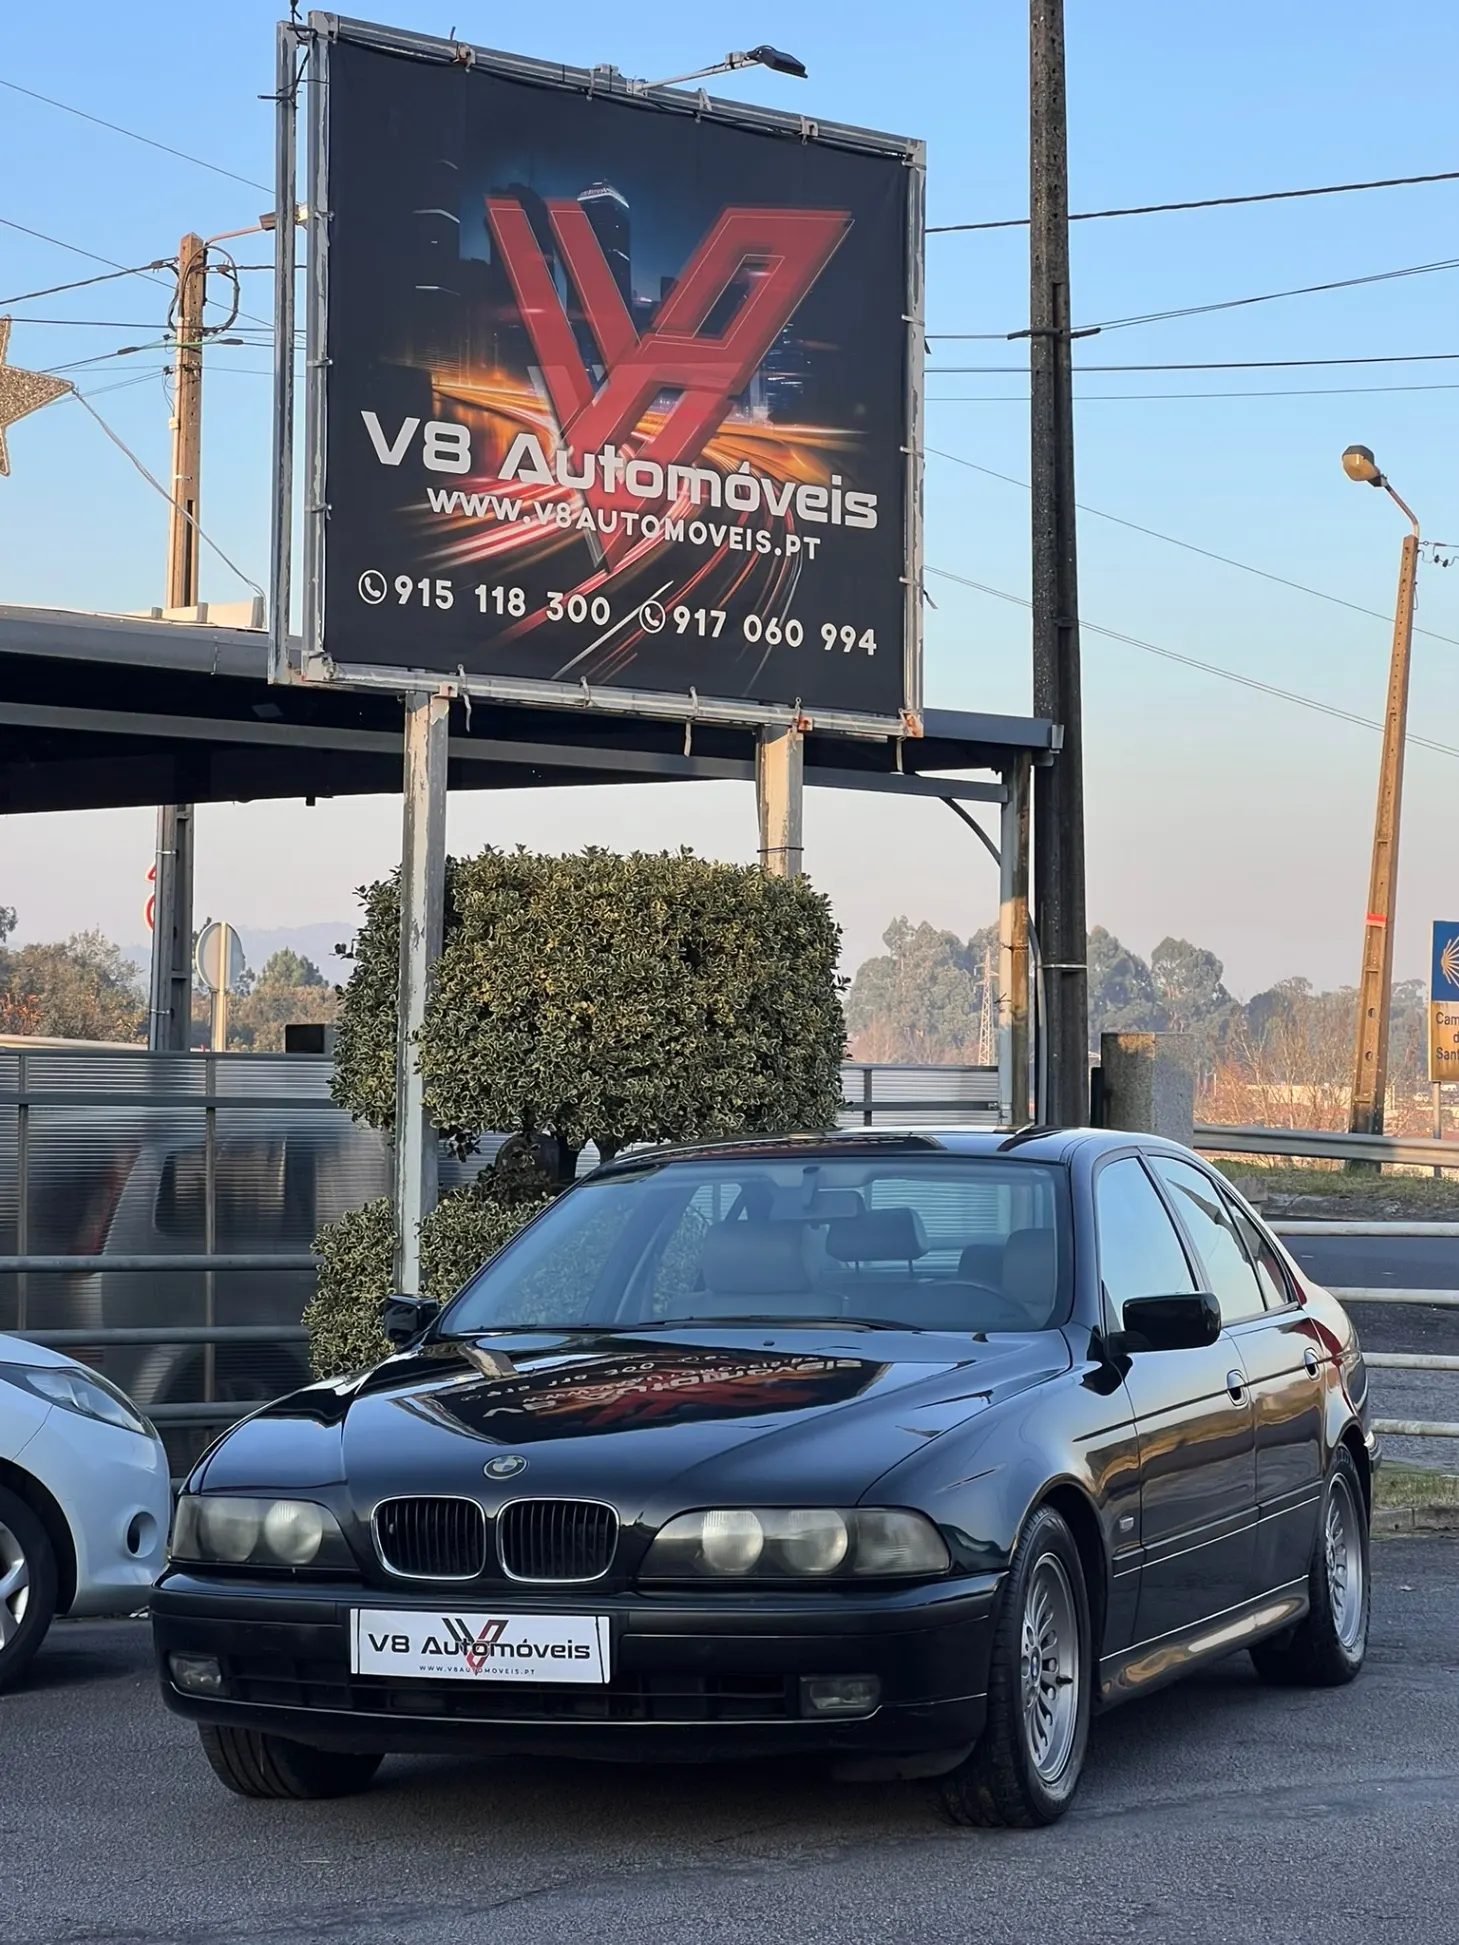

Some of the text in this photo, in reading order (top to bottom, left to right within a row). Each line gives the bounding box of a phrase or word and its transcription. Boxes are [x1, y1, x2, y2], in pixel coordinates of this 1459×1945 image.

[361, 410, 878, 529] V8 Automóveis
[427, 488, 821, 560] WWW.V8AUTOMOVEIS.PT
[394, 575, 877, 655] 915 118 300 917 060 994
[368, 1633, 591, 1659] V8 Automóveis
